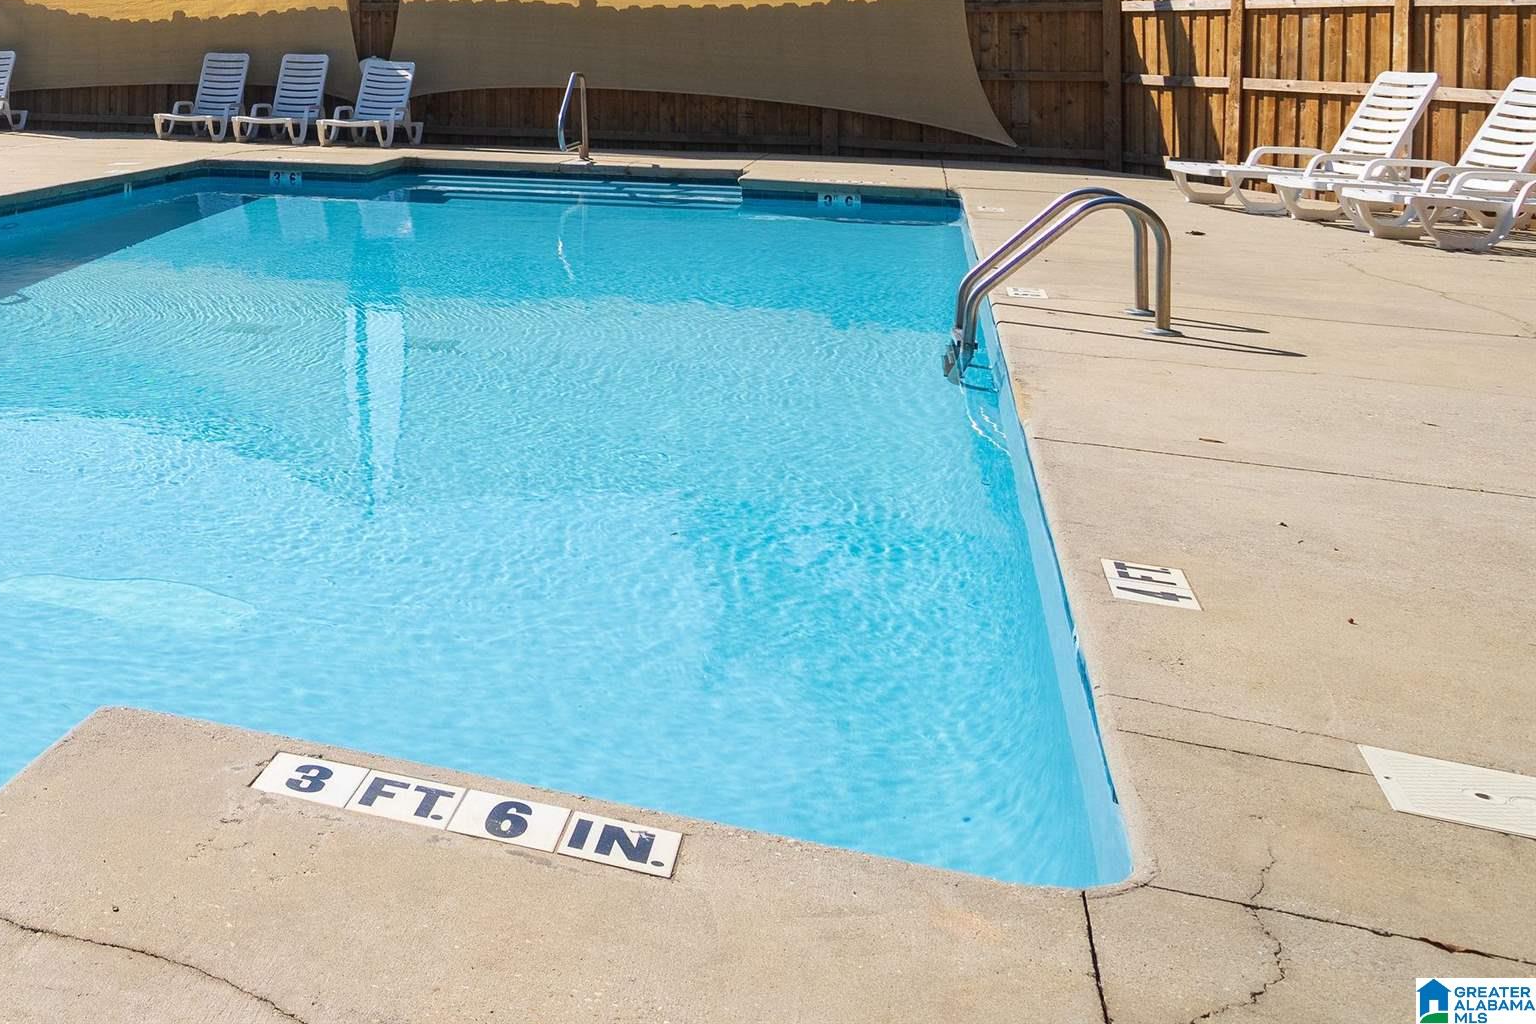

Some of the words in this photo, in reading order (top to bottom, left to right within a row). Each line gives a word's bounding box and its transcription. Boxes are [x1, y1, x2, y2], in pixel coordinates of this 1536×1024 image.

[285, 763, 334, 794] 3
[357, 776, 455, 821] FT.
[484, 800, 533, 839] 6
[566, 818, 665, 868] IN.
